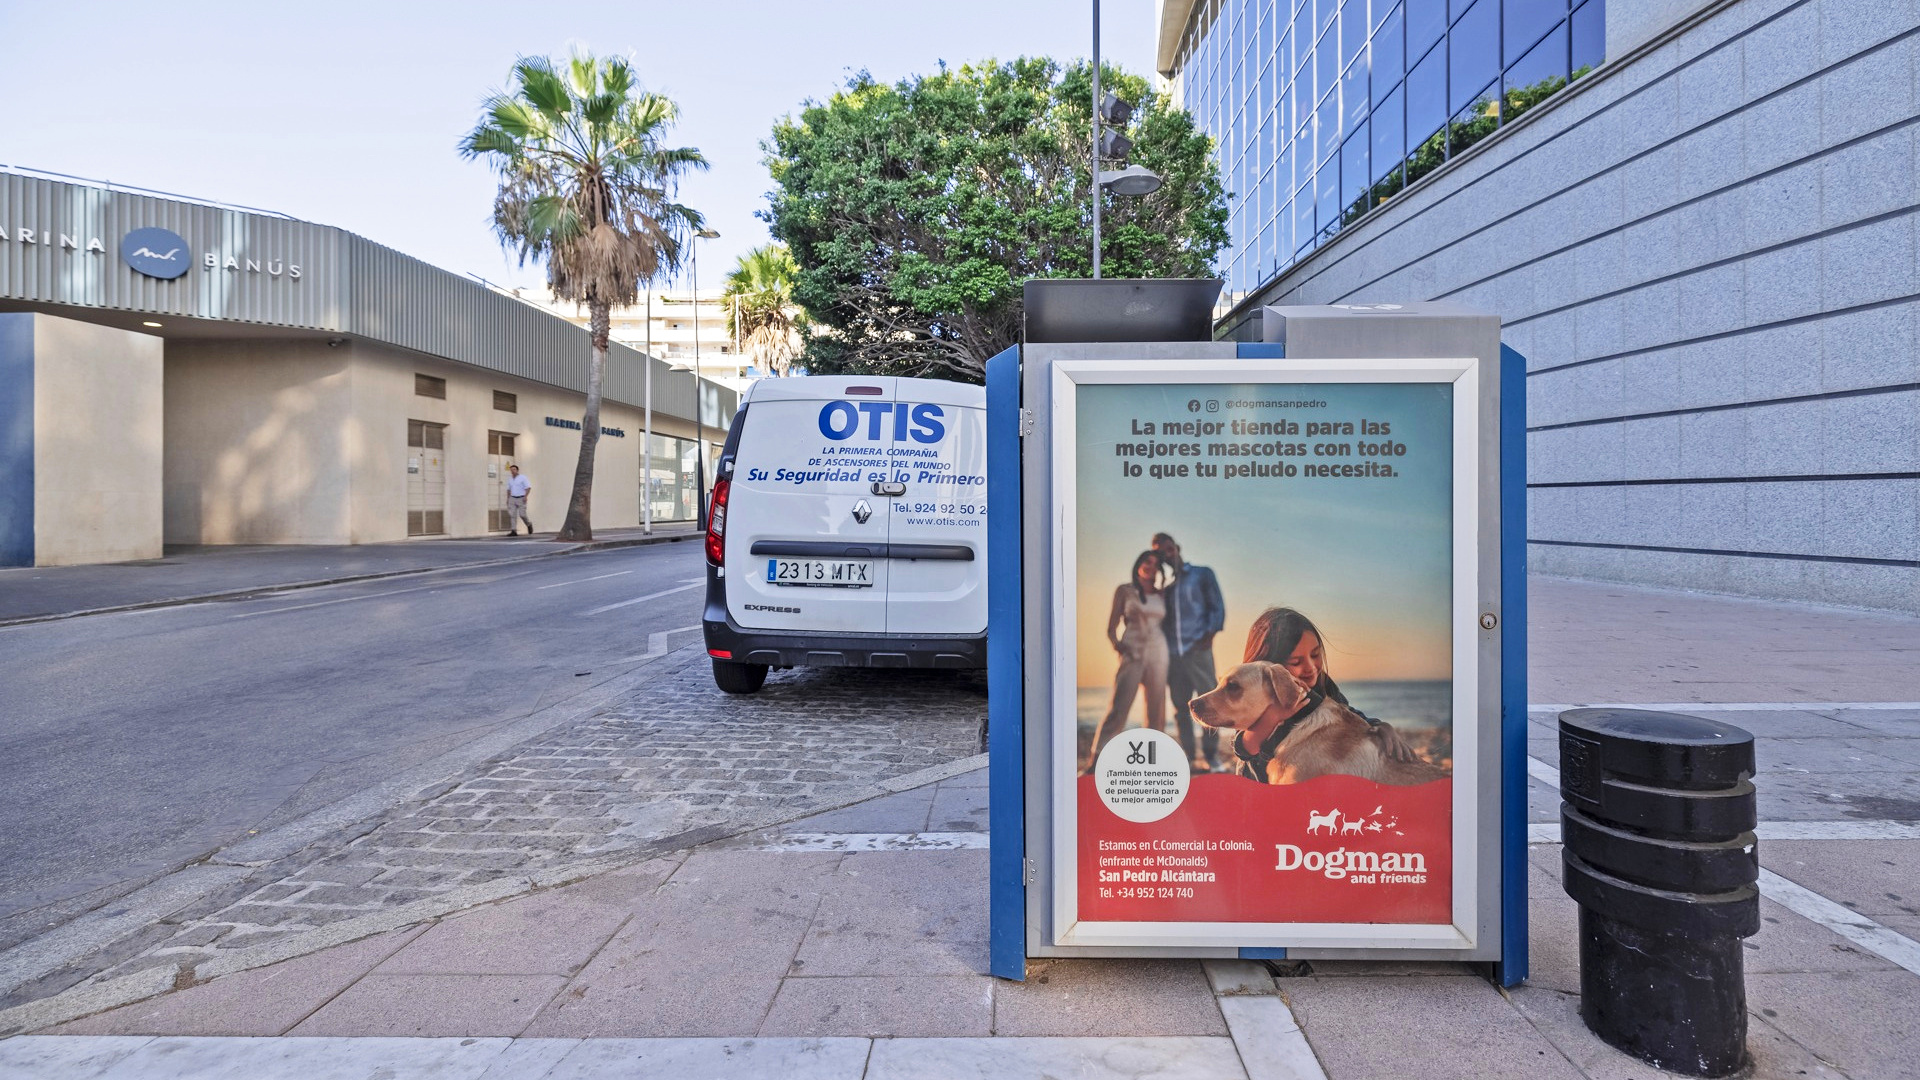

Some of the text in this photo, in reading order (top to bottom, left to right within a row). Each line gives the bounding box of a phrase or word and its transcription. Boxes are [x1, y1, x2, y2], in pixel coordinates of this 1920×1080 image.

[204, 252, 301, 278] BANÚS
[1225, 399, 1327, 410] @dogmansanpedro
[545, 416, 581, 431] MARINA
[818, 400, 945, 444] OTIS
[1131, 419, 1391, 438] La mejor tienda para las
[822, 447, 938, 458] LA PRIMERA COMPAÑIA
[1115, 440, 1407, 459] mejores mascotas con todo
[808, 458, 951, 470] DE ASCENSORES DEL MUNDO
[1123, 461, 1399, 480] lo que tu peludo necesita.
[747, 468, 986, 486] Su Seguridad es lo Primero
[893, 503, 987, 515] Tel. 924 92 50 2
[907, 518, 980, 527] www.otis.com
[779, 562, 867, 581] 2313 MTX
[744, 604, 801, 614] EXPRESS
[1119, 779, 1142, 787] mejor
[1117, 787, 1159, 796] peluquería
[1161, 788, 1179, 796] para
[1146, 796, 1173, 804] amigo!
[1099, 840, 1255, 852] Estamos en C.Comercial La Colonia,
[1099, 856, 1208, 868] (enfrante de McDonalds)
[1275, 844, 1427, 880] Dogman
[1099, 869, 1216, 882] San Pedro Alcántara
[1350, 873, 1426, 885] and friends
[1099, 887, 1194, 898] Tel. +34 952 124 740
